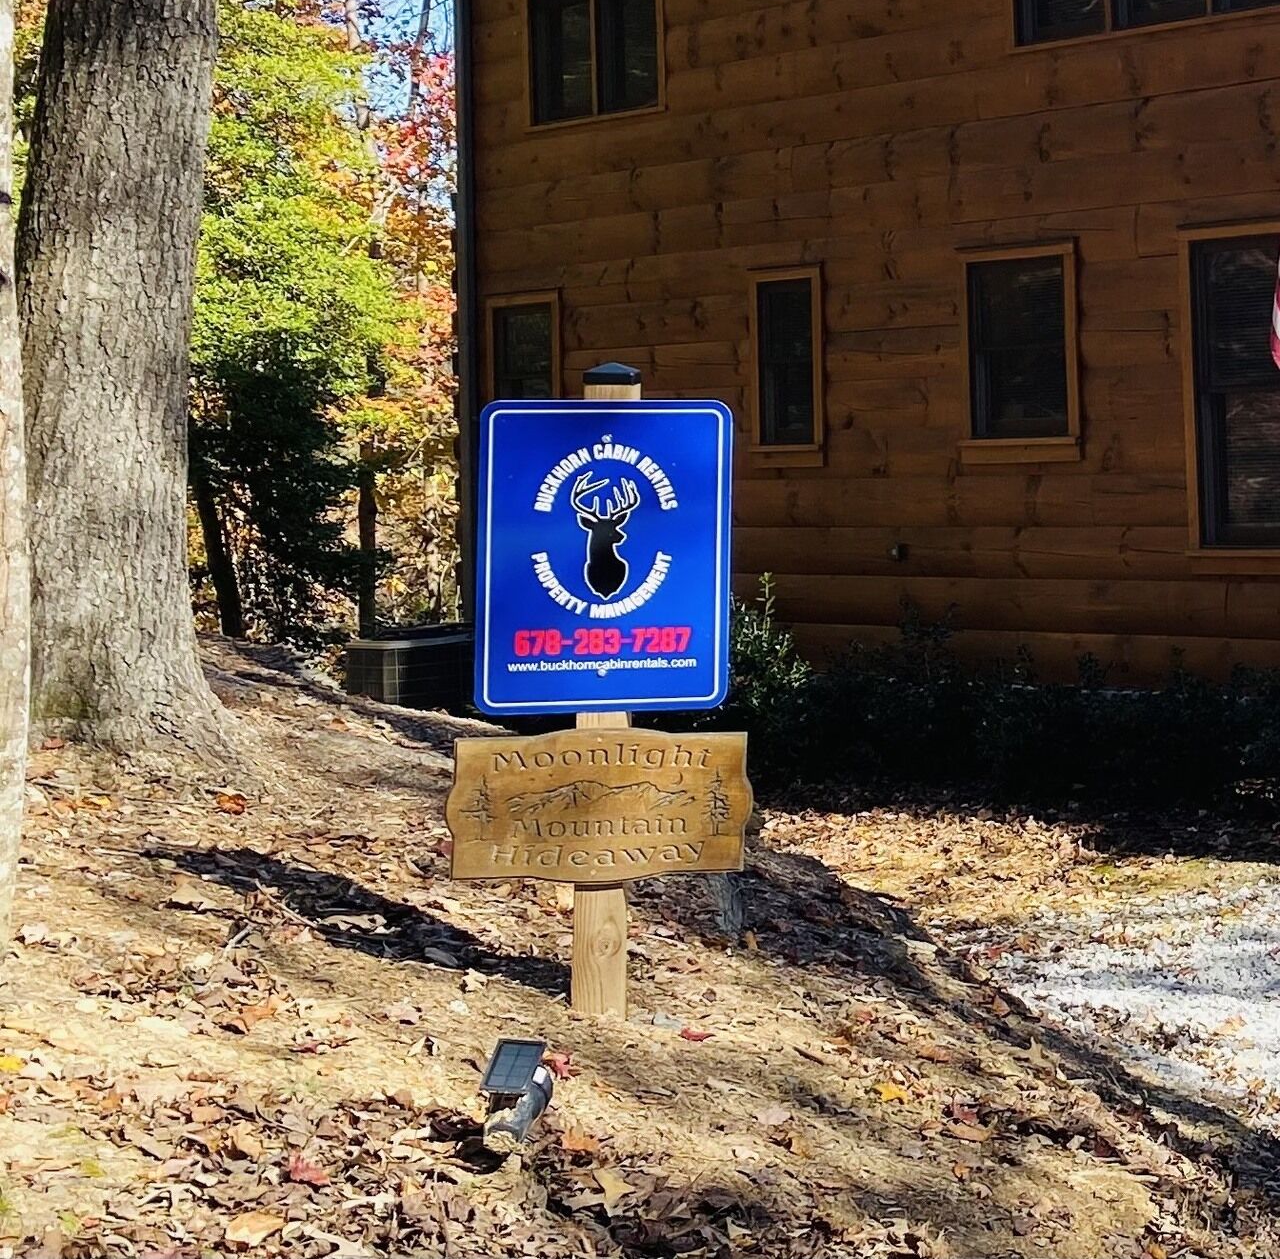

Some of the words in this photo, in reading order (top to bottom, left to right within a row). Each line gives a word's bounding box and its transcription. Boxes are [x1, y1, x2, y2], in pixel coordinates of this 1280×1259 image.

[534, 447, 593, 513] BUCKHORN
[593, 443, 641, 465] CABIN
[637, 456, 679, 511] RENTALS
[531, 551, 588, 615] PROPERTY
[589, 551, 673, 619] MANAGEMENT
[514, 627, 692, 657] 678-283-7287
[492, 743, 712, 772] Moonlight
[510, 813, 688, 839] Mountain
[491, 840, 705, 867] Hideaway
